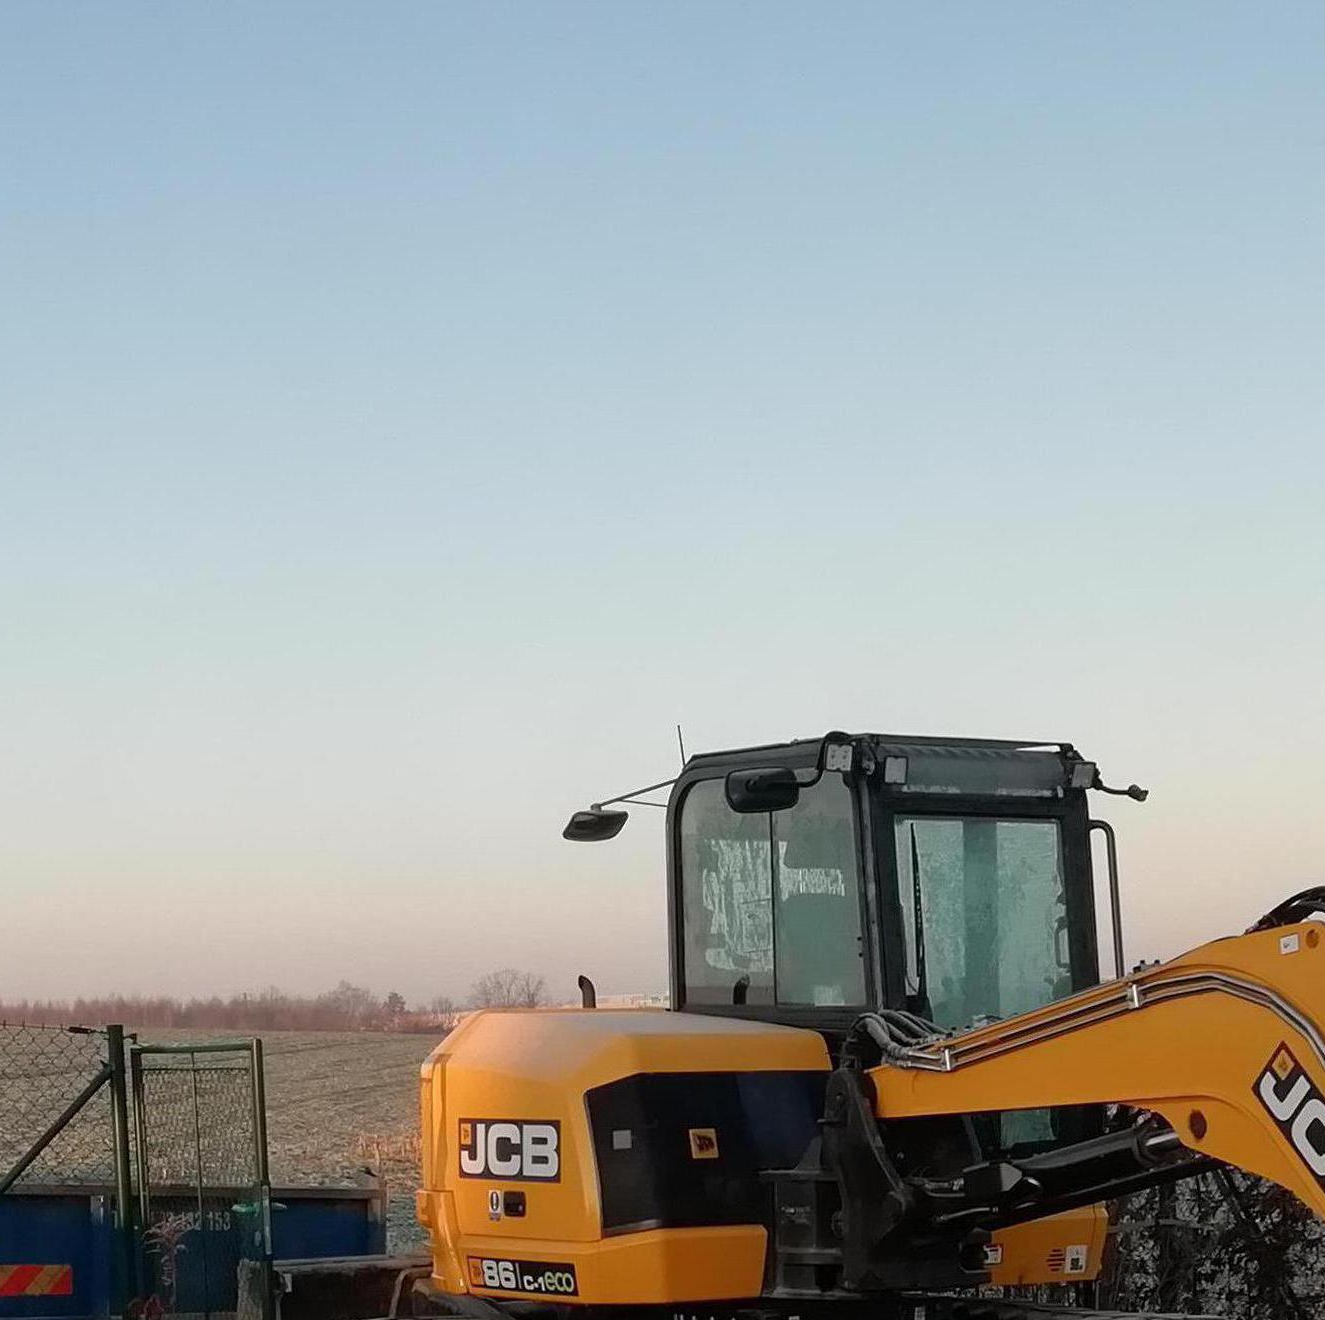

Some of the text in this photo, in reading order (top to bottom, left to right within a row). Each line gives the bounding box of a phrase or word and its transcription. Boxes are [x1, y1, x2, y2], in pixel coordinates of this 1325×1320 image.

[460, 1123, 559, 1177] JCB
[207, 1211, 231, 1231] 153
[482, 1260, 517, 1289] 86
